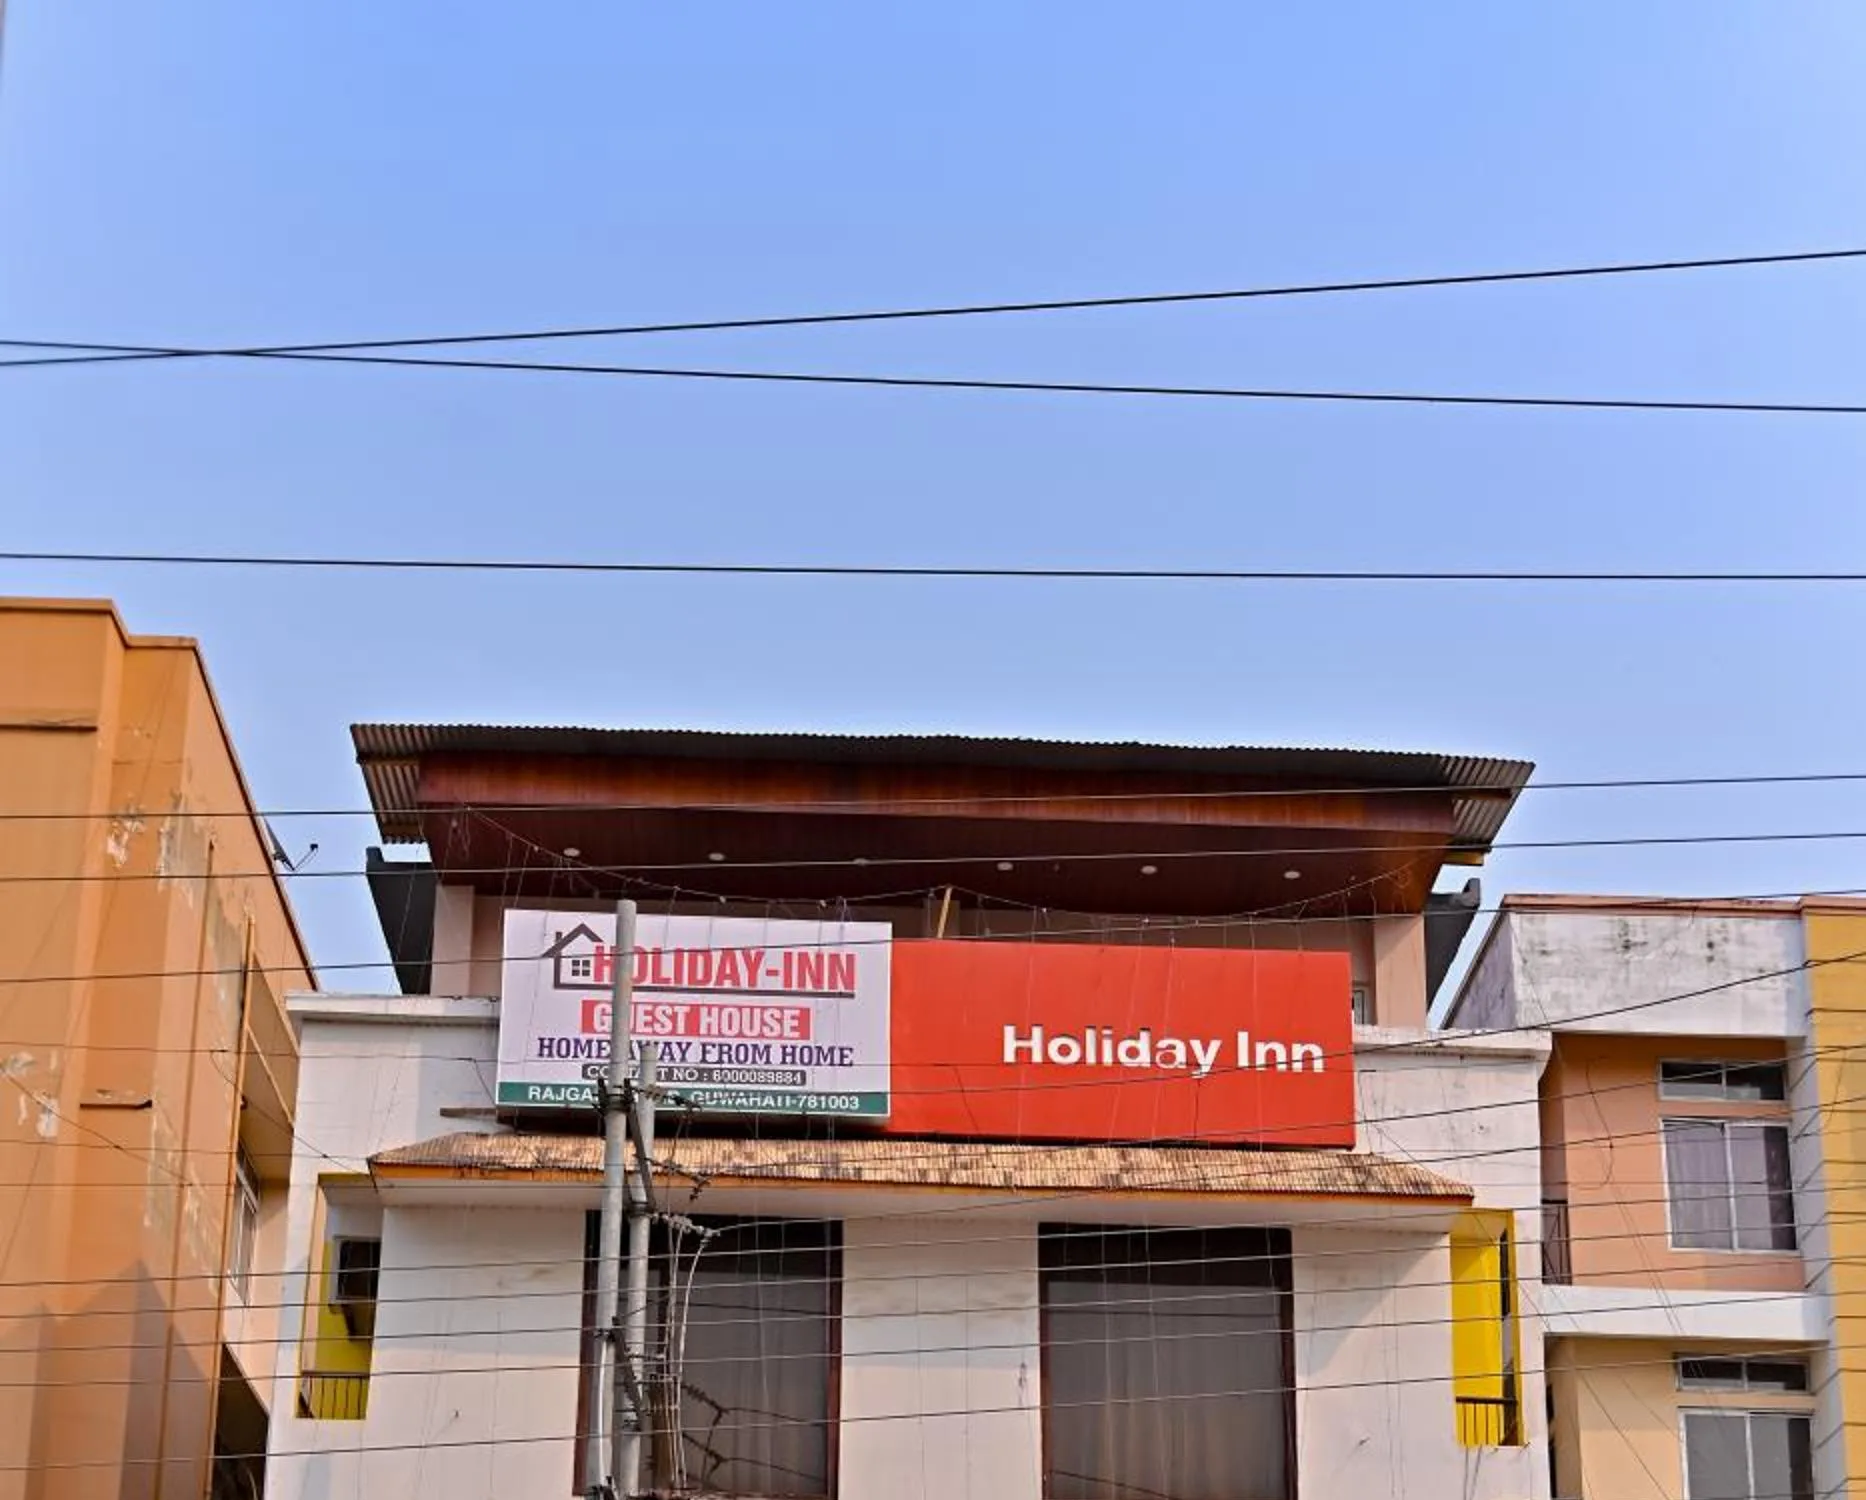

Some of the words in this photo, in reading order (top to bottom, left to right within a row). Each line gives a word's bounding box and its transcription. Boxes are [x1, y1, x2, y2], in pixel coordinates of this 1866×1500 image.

[593, 943, 856, 991] HOLIDAY-INN
[593, 1002, 690, 1035] GEST
[700, 1006, 800, 1037] HOUSE
[538, 1037, 613, 1060] HOME
[700, 1043, 773, 1065] FROM
[780, 1045, 855, 1067] HOME
[1003, 1024, 1222, 1079] Holiday
[1237, 1031, 1325, 1073] Inn
[672, 1067, 699, 1082] NO
[528, 1085, 612, 1102] RAJGA
